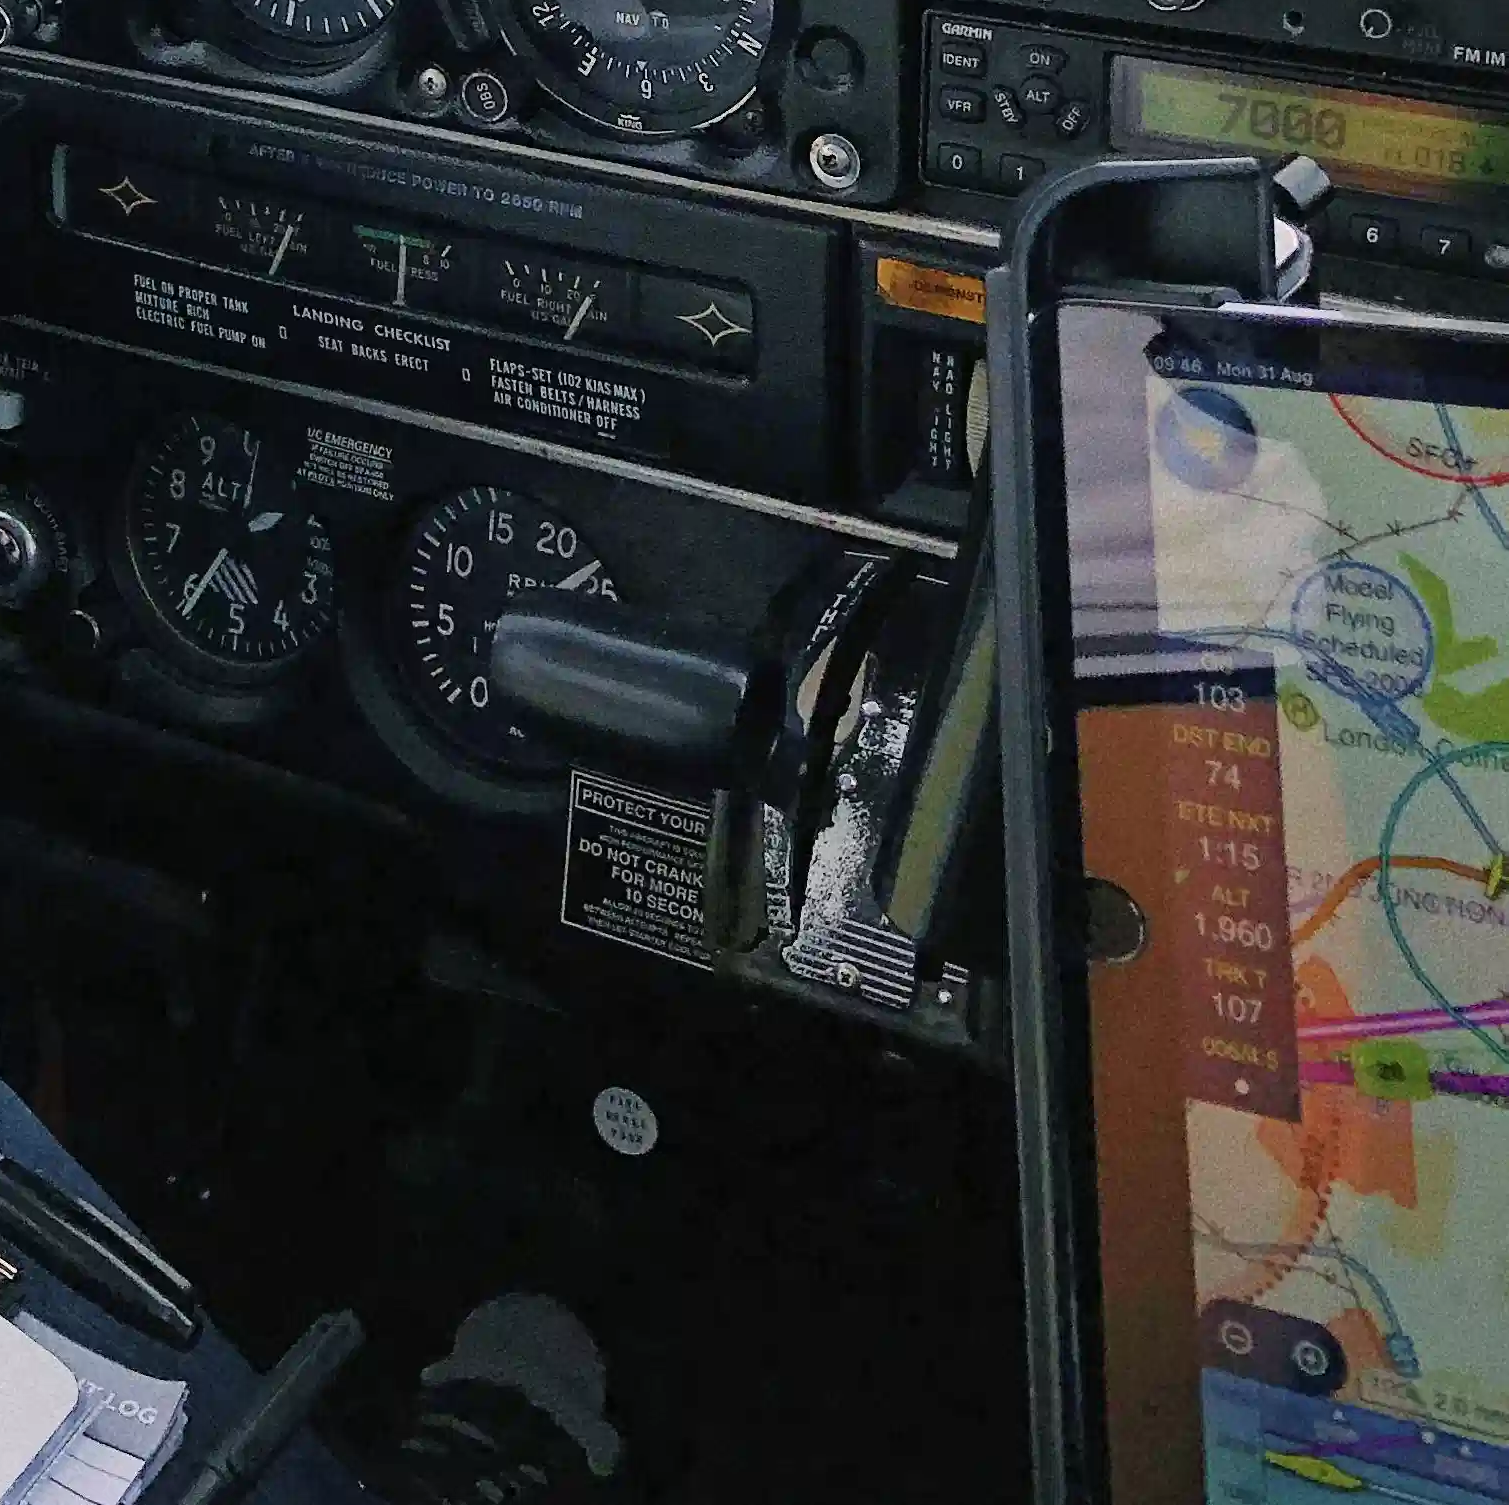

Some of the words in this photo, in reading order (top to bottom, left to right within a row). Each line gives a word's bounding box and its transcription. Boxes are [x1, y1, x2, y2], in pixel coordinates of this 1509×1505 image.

[616, 12, 639, 26] NAV
[942, 22, 992, 41] GARMIN
[943, 52, 980, 69] IDENT
[1029, 52, 1051, 66] ON
[1453, 46, 1481, 64] FM
[476, 81, 496, 111] OBS
[948, 99, 971, 112] VFR
[994, 91, 1019, 125] STBY
[1025, 90, 1050, 103] ALT
[1061, 106, 1083, 132] OFF
[1216, 93, 1346, 150] 7000
[473, 185, 494, 202] TO
[134, 274, 156, 291] FUEL
[161, 281, 175, 297] ON
[178, 284, 218, 307] PROPER
[222, 296, 249, 314] TANK
[135, 291, 179, 314] MIXTURE
[136, 306, 185, 330] ELECTRIC
[190, 320, 215, 338] FUEL
[219, 328, 247, 346] PUMP
[251, 334, 266, 349] ON
[292, 305, 364, 332] LANDING
[374, 323, 451, 352] CHECKLIST
[318, 335, 343, 353] SEAT
[351, 344, 388, 363] BACKS
[394, 353, 429, 373] ERECT
[490, 358, 552, 385] FLAPS-SET
[585, 377, 611, 396] KIAS
[491, 375, 533, 396] FASTEN
[1217, 360, 1253, 378] Mon
[1258, 364, 1276, 380] 31
[1279, 368, 1314, 386] Aug
[493, 391, 512, 408] AIR
[517, 396, 591, 425] CONDITIONER
[596, 415, 618, 431] OFF
[324, 431, 393, 458] EMERGENCY
[488, 509, 514, 545] 15
[536, 521, 577, 558] 20
[1325, 602, 1396, 635] Flying
[1193, 681, 1247, 714] 103
[1203, 759, 1242, 790] 74
[582, 787, 655, 821] PROTECT
[659, 811, 706, 837] YOUR
[578, 837, 603, 856] DO
[607, 847, 640, 869] NOT
[644, 856, 705, 889] CRANK
[611, 866, 645, 887] FOR
[648, 875, 699, 904] MORE
[625, 888, 643, 903] 10
[1210, 886, 1251, 909] ALT
[1213, 993, 1263, 1025] 107
